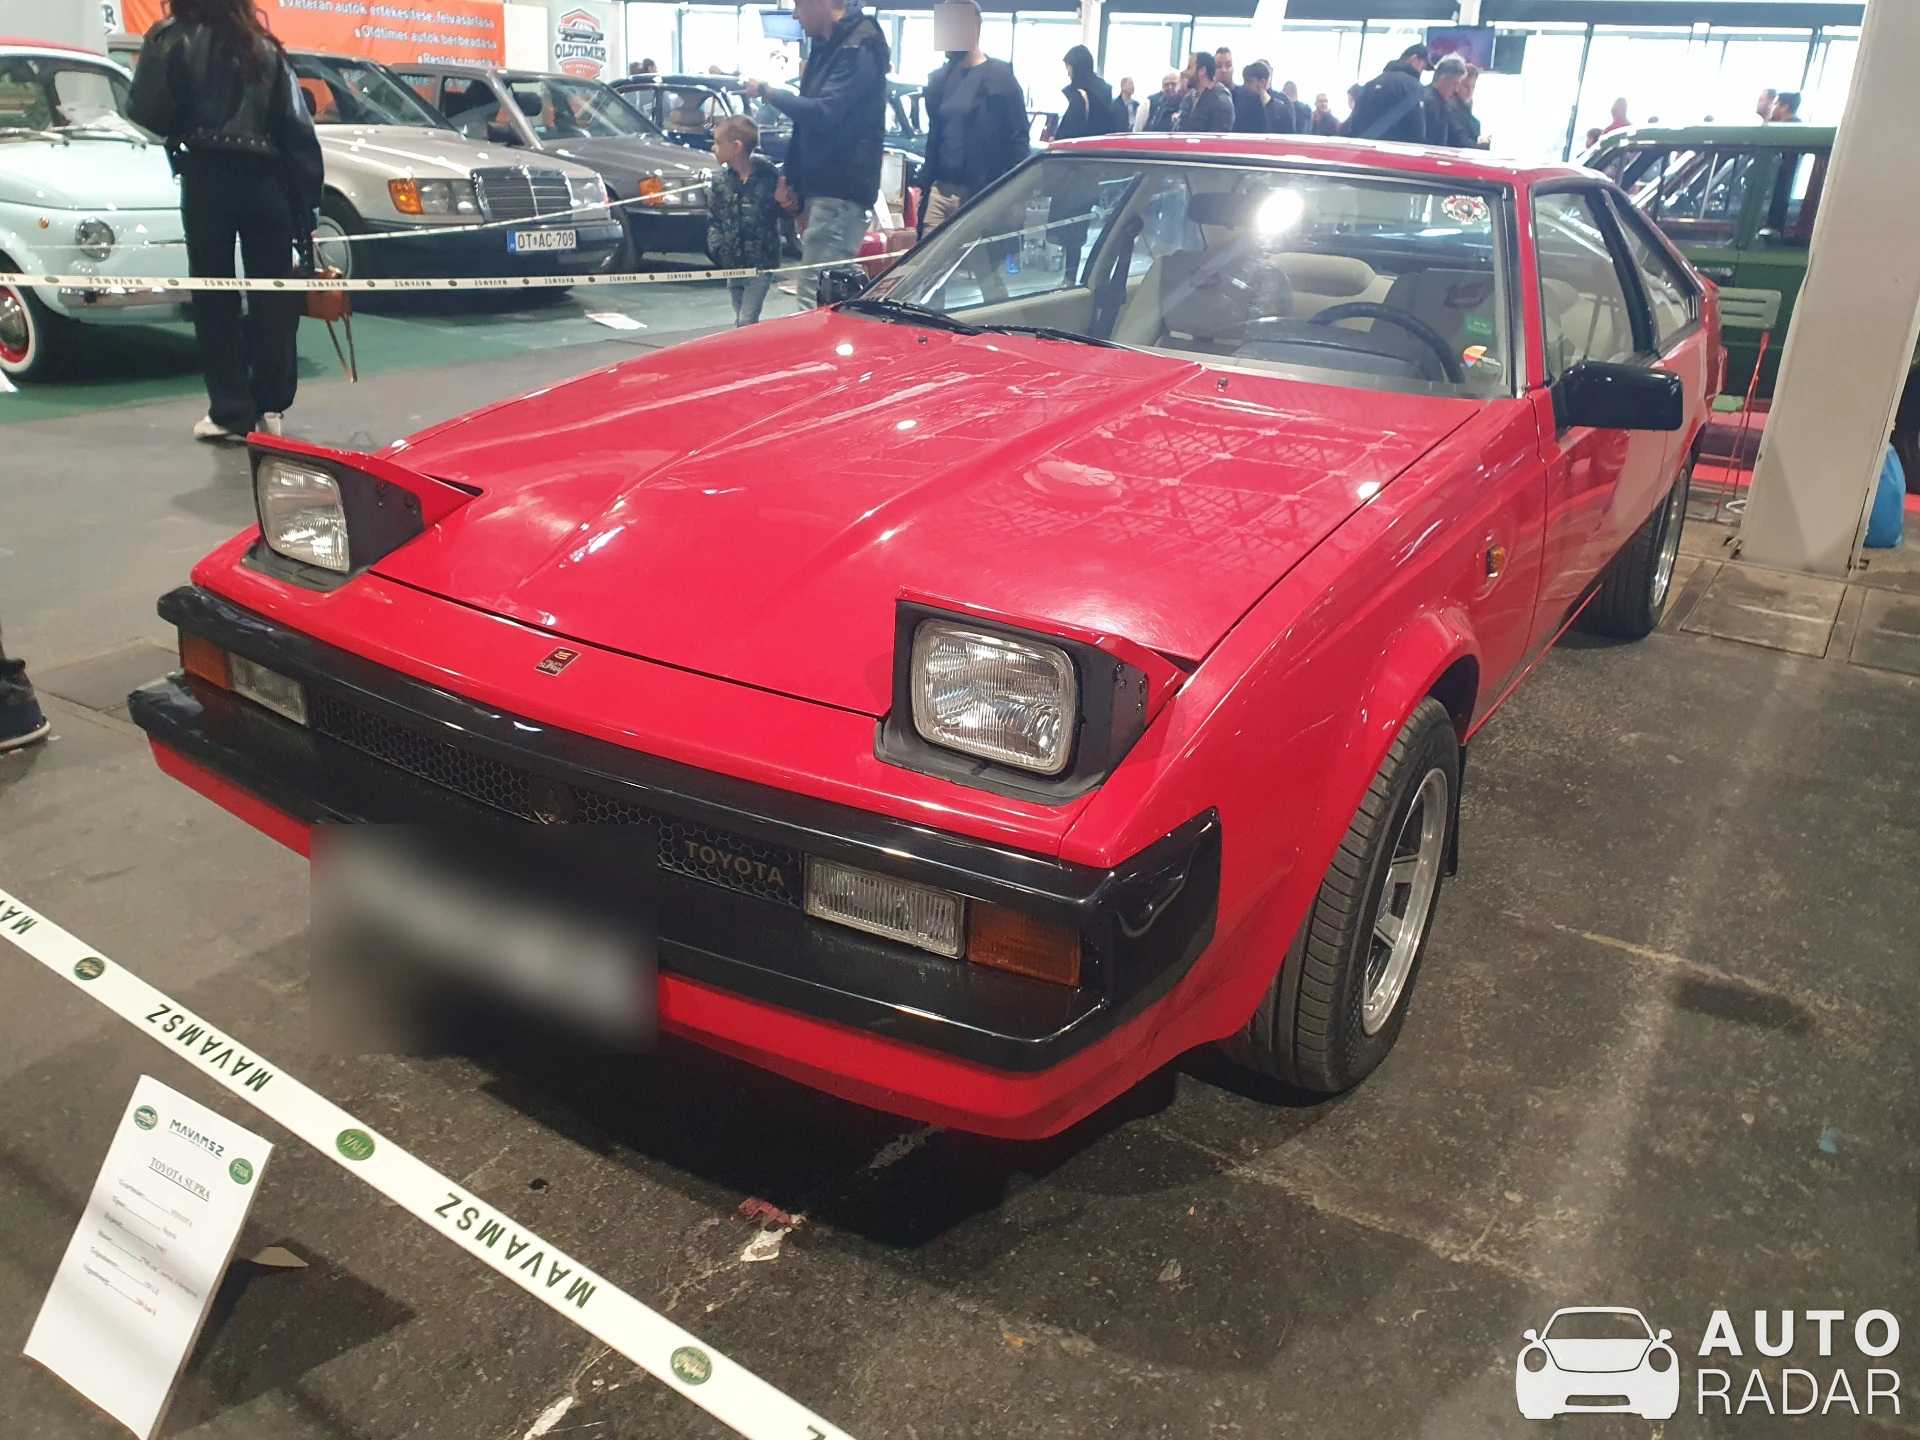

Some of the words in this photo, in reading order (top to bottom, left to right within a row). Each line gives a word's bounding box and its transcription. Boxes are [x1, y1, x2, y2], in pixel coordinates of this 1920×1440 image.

[361, 24, 408, 41] Oldtimer
[554, 43, 606, 62] OLDTIMER
[517, 234, 532, 249] OT
[684, 840, 785, 886] TOYOTA
[145, 1003, 274, 1092] MAVAMSZ
[169, 1118, 225, 1158] MAVAMSZ
[150, 1157, 184, 1182] TOYOTA
[184, 1177, 211, 1200] SUPRA
[433, 1191, 597, 1310] MAVAMSZ
